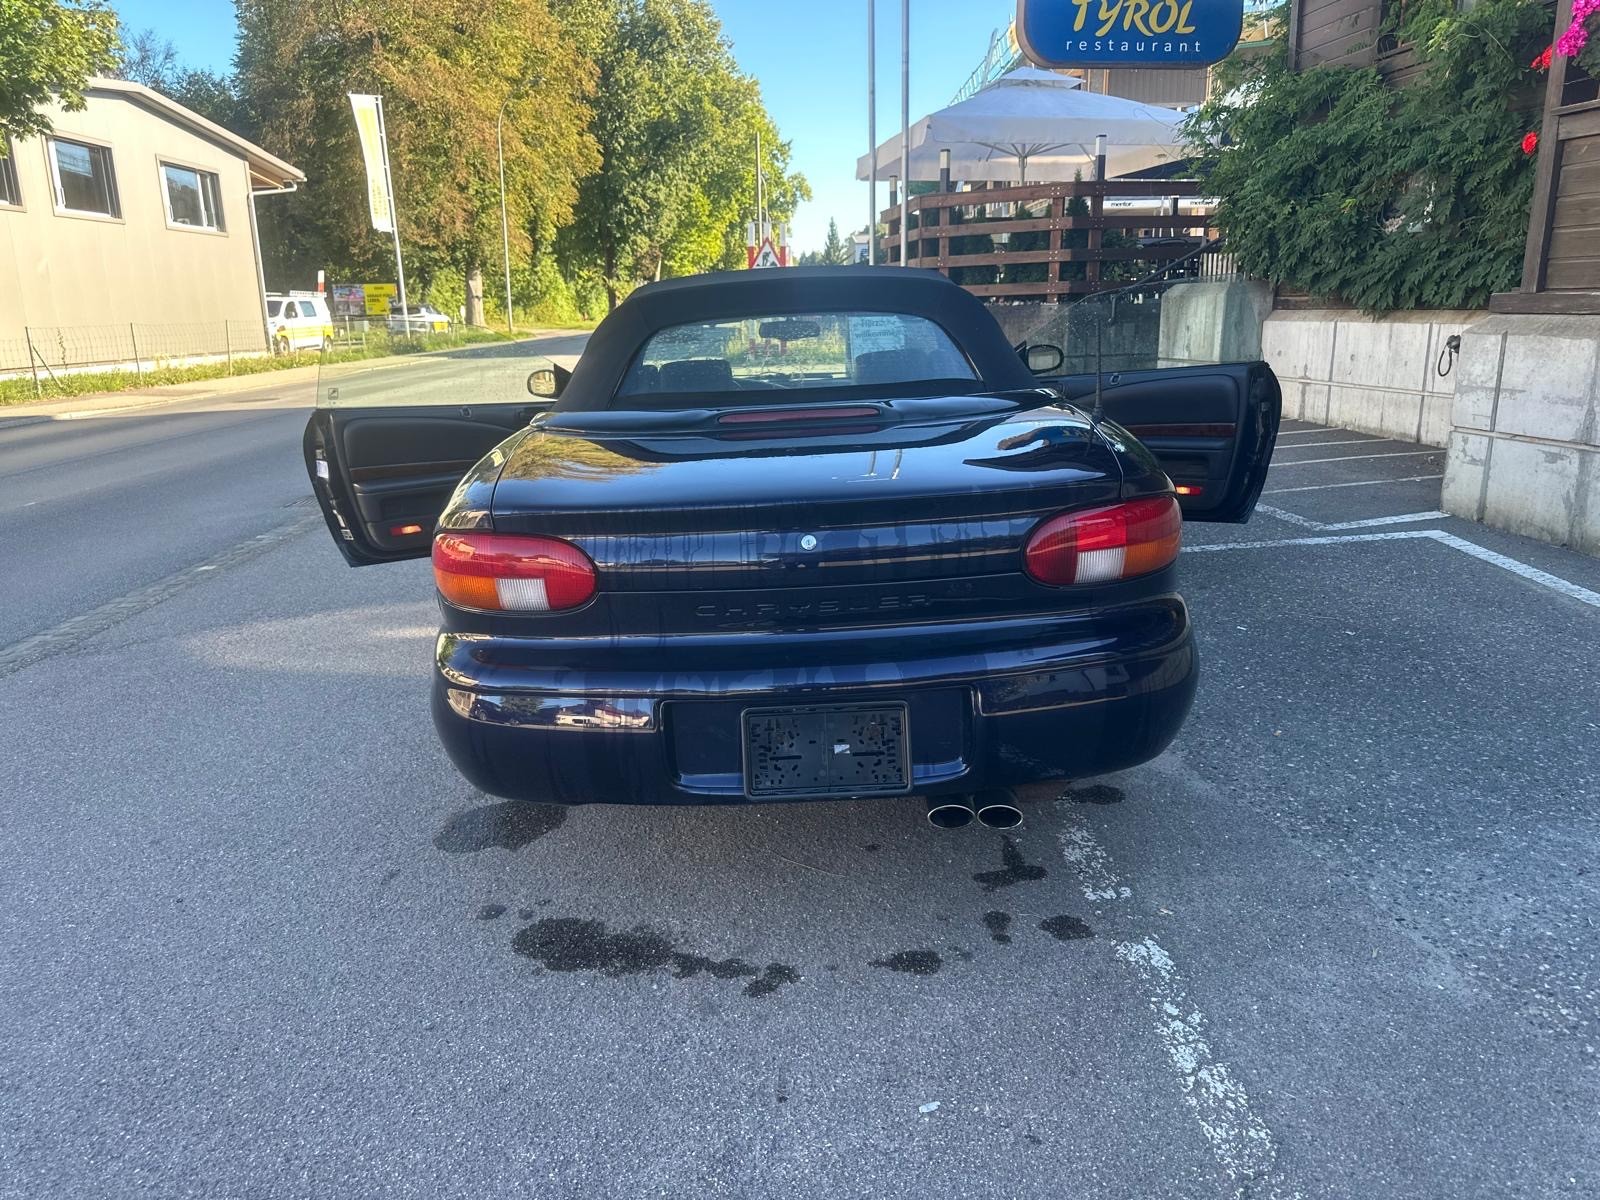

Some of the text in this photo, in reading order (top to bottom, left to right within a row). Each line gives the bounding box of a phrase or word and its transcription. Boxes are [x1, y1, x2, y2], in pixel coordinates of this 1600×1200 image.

[1071, 0, 1196, 37] TYROL
[1066, 39, 1201, 53] restaurant
[695, 594, 931, 617] CHRYSLER
